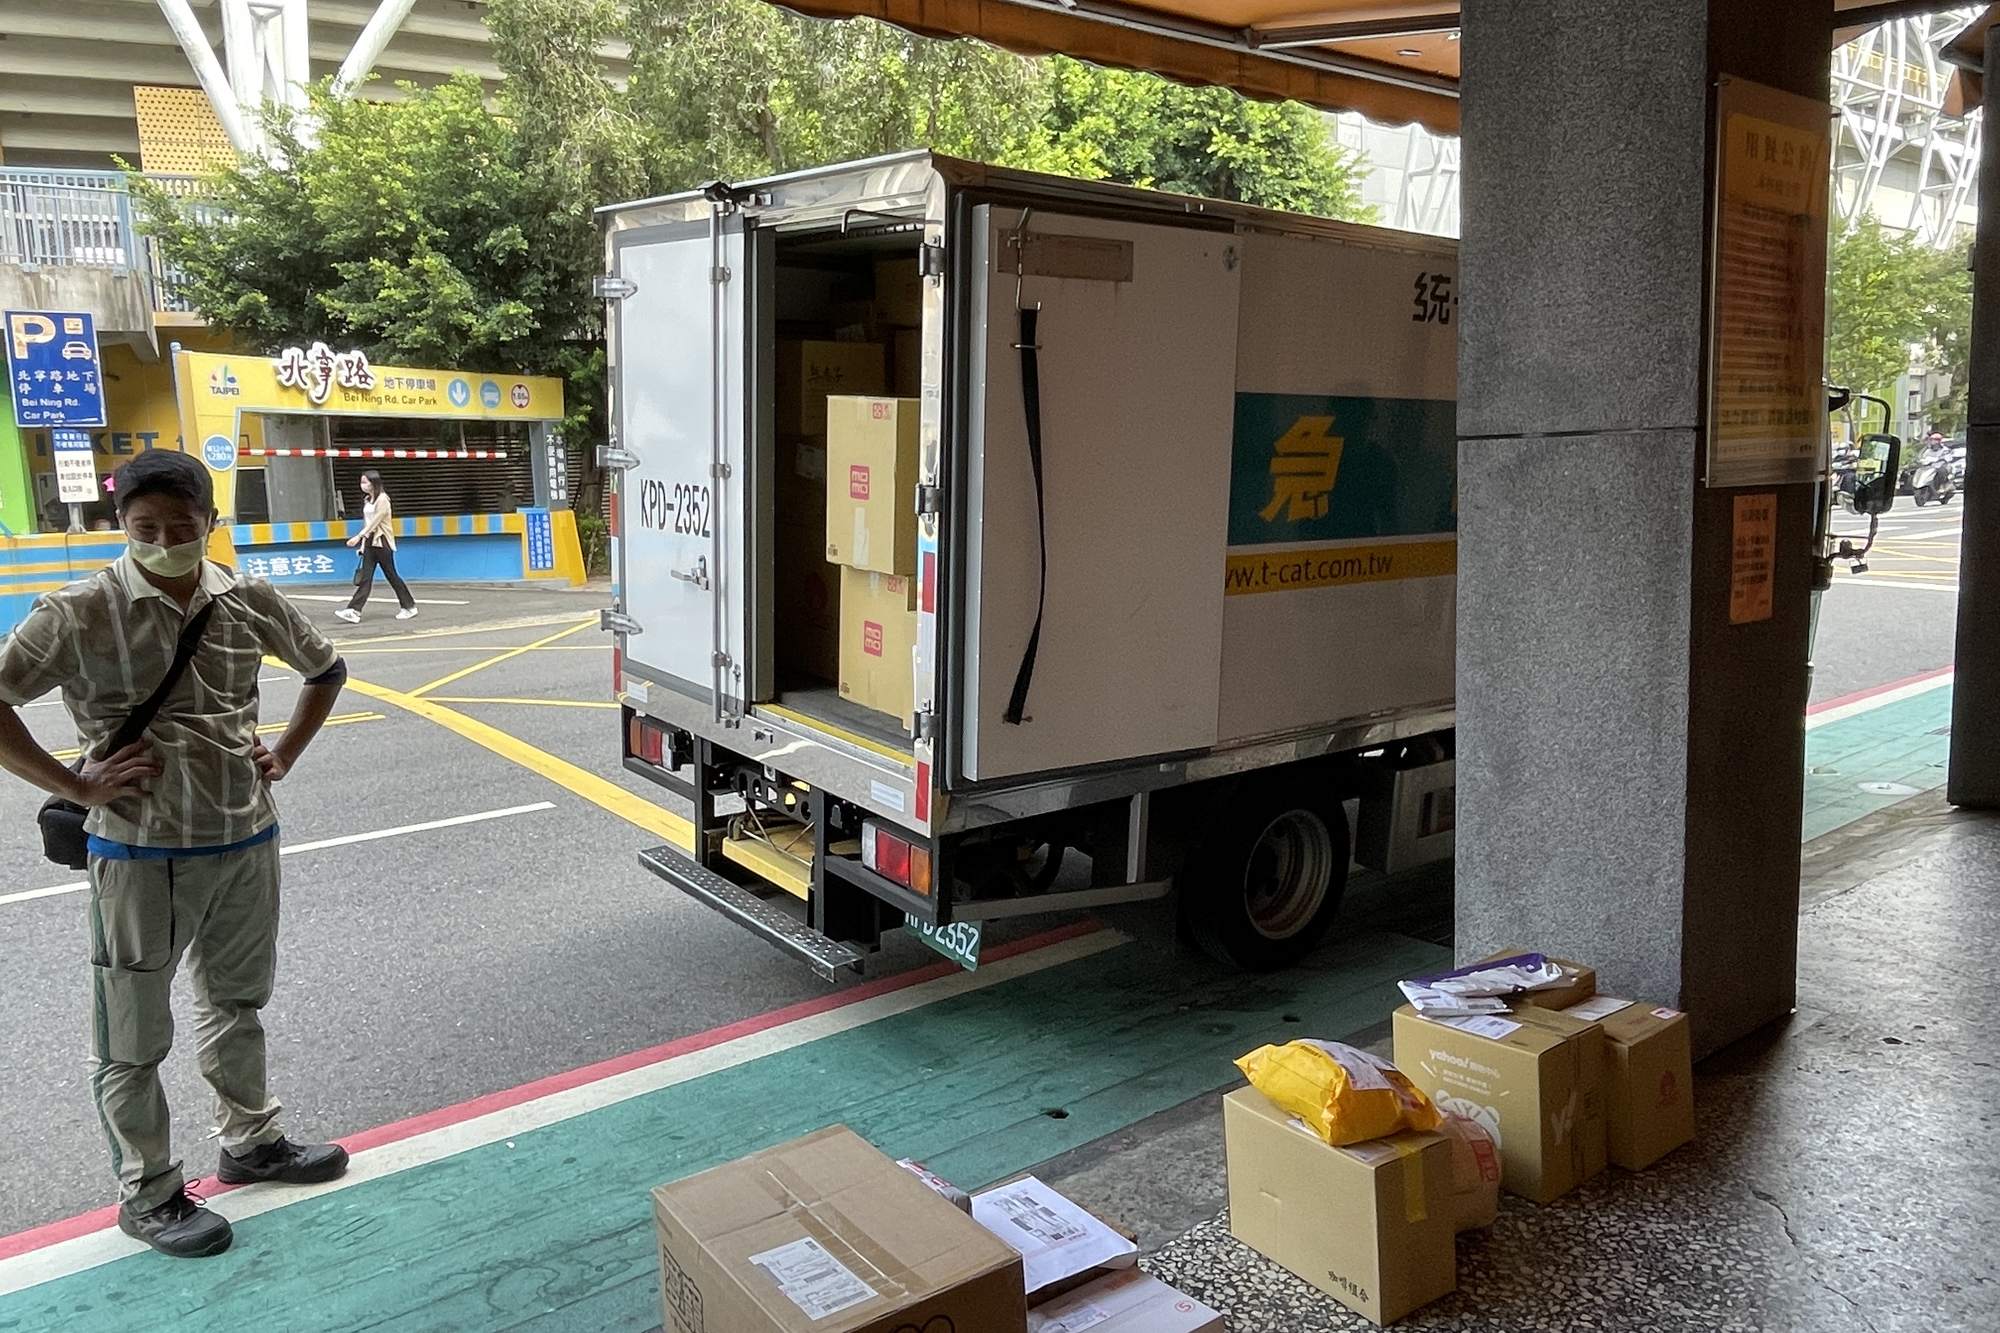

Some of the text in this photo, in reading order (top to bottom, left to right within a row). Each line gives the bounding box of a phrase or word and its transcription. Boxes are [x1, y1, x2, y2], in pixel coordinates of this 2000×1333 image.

[11, 314, 57, 360] P
[17, 369, 96, 382] 北寧路地下
[18, 382, 97, 396] 停車場
[211, 386, 240, 395] TAIPEI
[384, 377, 436, 391] 地下停車場
[22, 398, 81, 409] Bei Ning Rd.
[345, 392, 438, 406] Bei Ning Rd. Car Park
[23, 411, 66, 420] Car Park
[640, 479, 710, 538] KPD-2352
[247, 554, 336, 578] 注意安全
[1428, 1048, 1469, 1069] yahoo!
